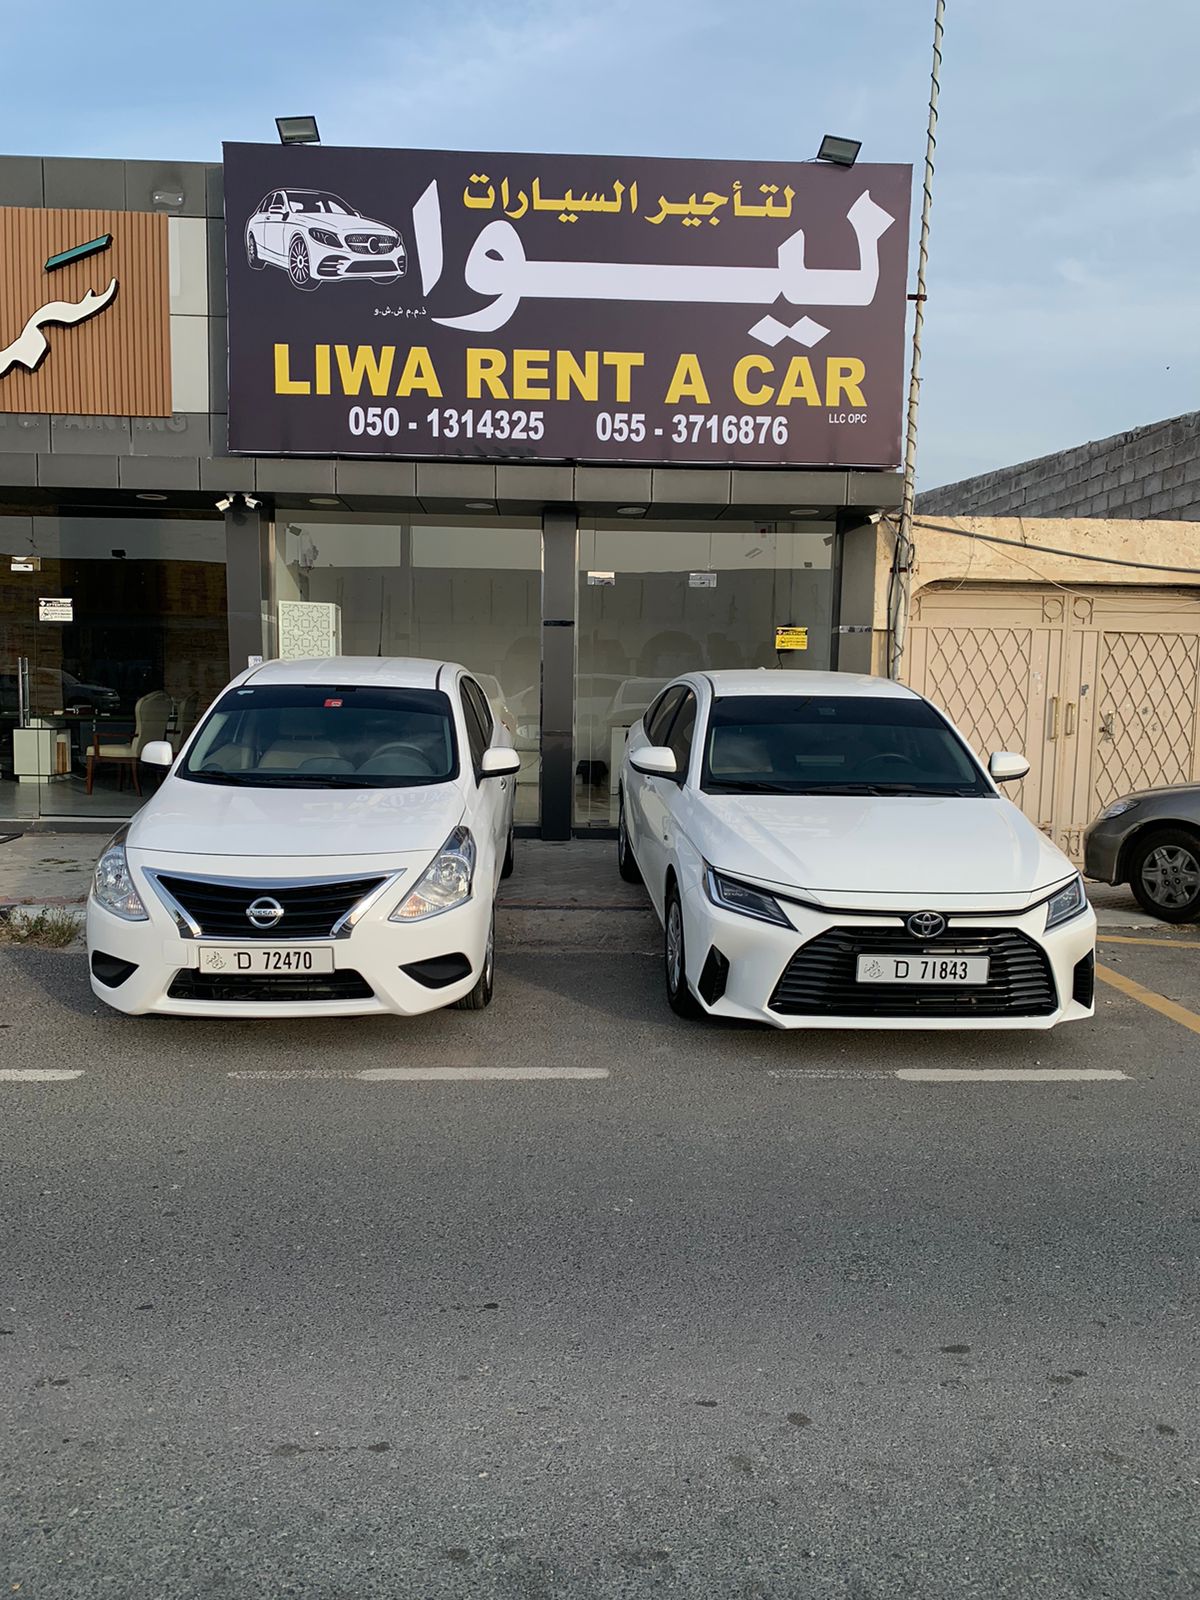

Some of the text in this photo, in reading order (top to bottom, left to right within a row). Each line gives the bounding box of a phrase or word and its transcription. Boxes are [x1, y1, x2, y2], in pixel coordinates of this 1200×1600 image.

[462, 174, 796, 228] لتأجير السيارات
[412, 178, 896, 349] ليوا
[273, 343, 867, 409] LIWA RENT A CAR
[348, 405, 400, 437] 050
[426, 407, 545, 441] 1314325
[596, 411, 646, 443] 055
[671, 413, 789, 446] 3716876
[828, 413, 867, 424] LLC OPC
[237, 952, 252, 970] D
[262, 951, 312, 970] 72470
[895, 960, 910, 979] D
[920, 961, 968, 980] 71843
